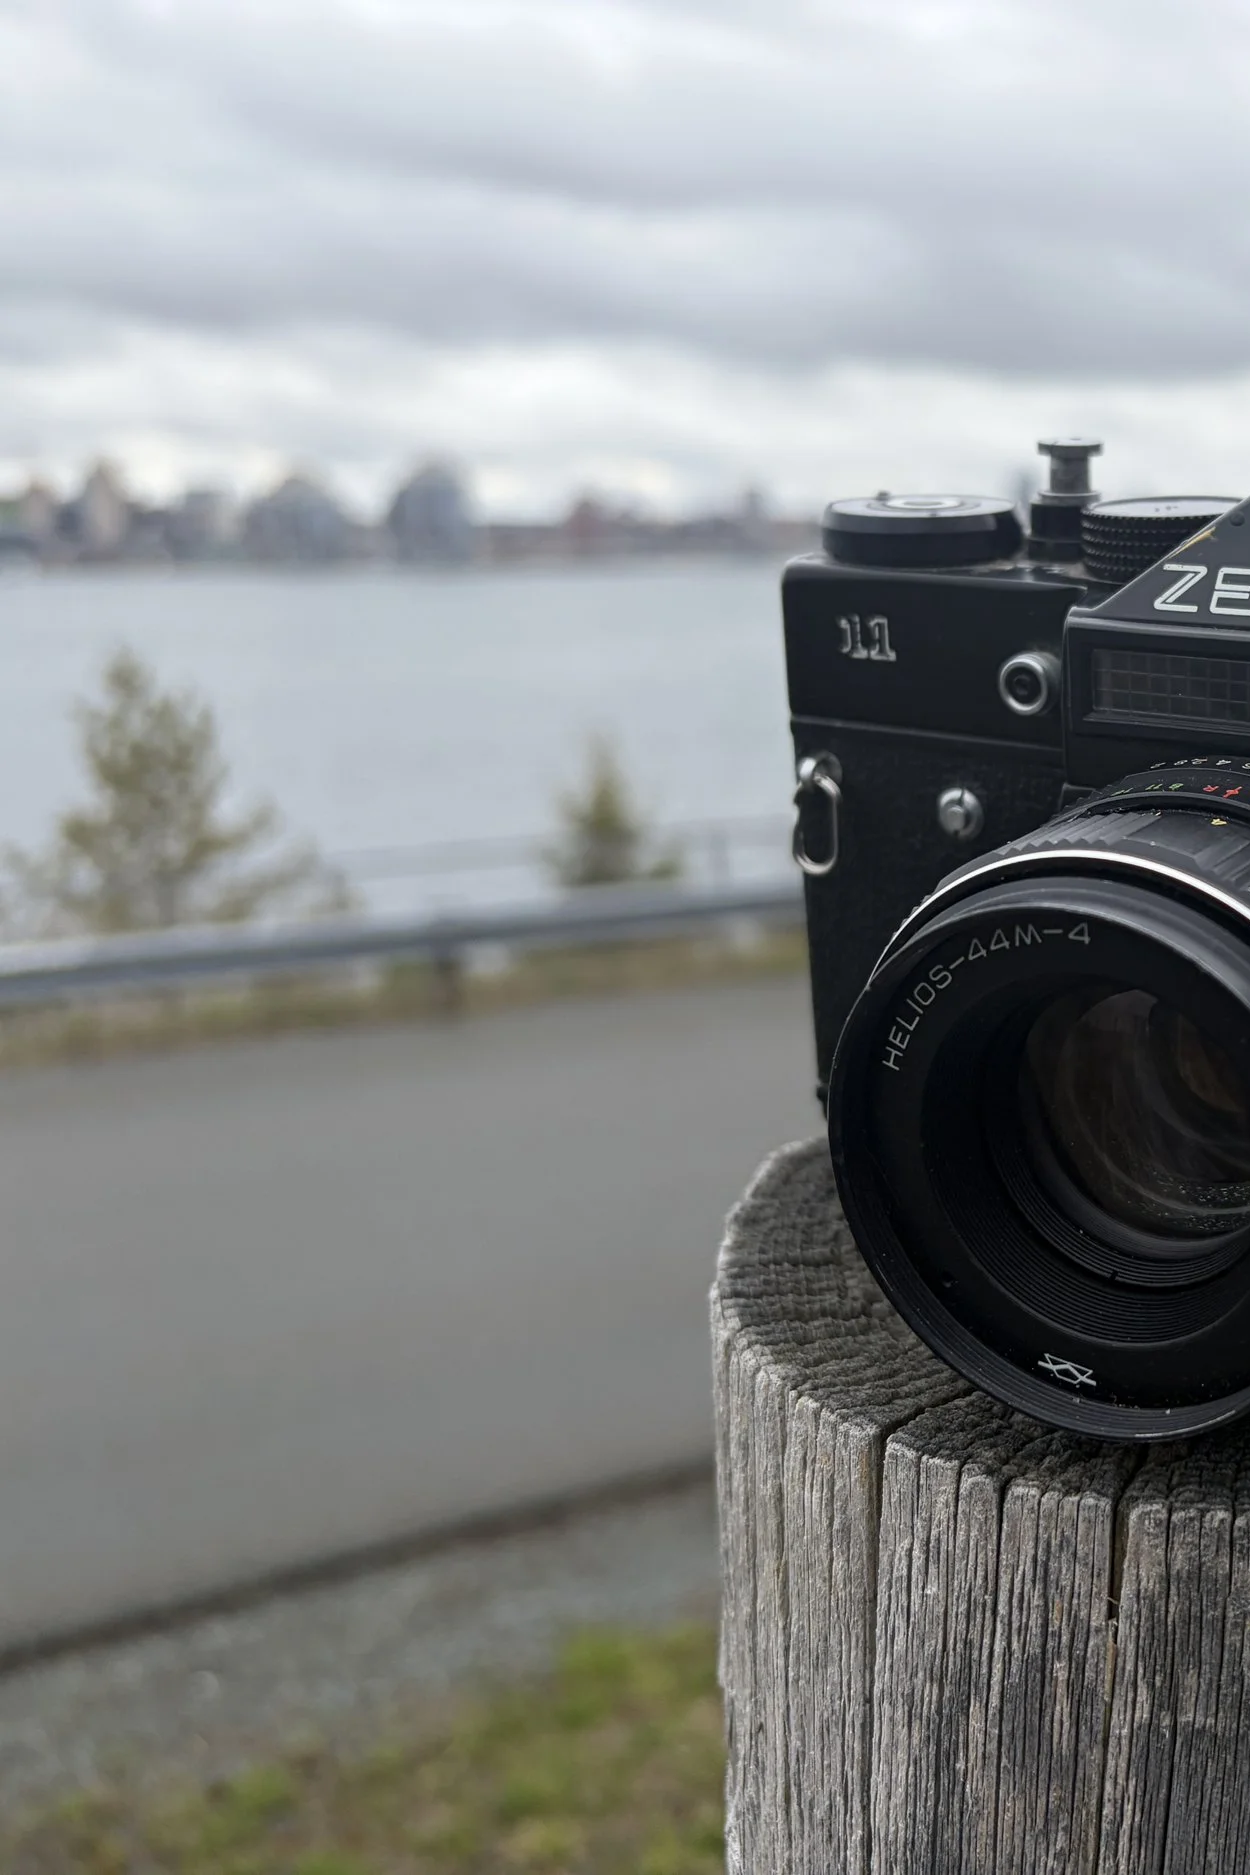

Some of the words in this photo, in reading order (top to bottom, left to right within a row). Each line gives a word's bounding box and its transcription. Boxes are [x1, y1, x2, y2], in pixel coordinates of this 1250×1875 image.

[836, 613, 897, 661] 11
[1211, 818, 1227, 826] 4
[882, 922, 1092, 1071] HELIOS-44M-4
